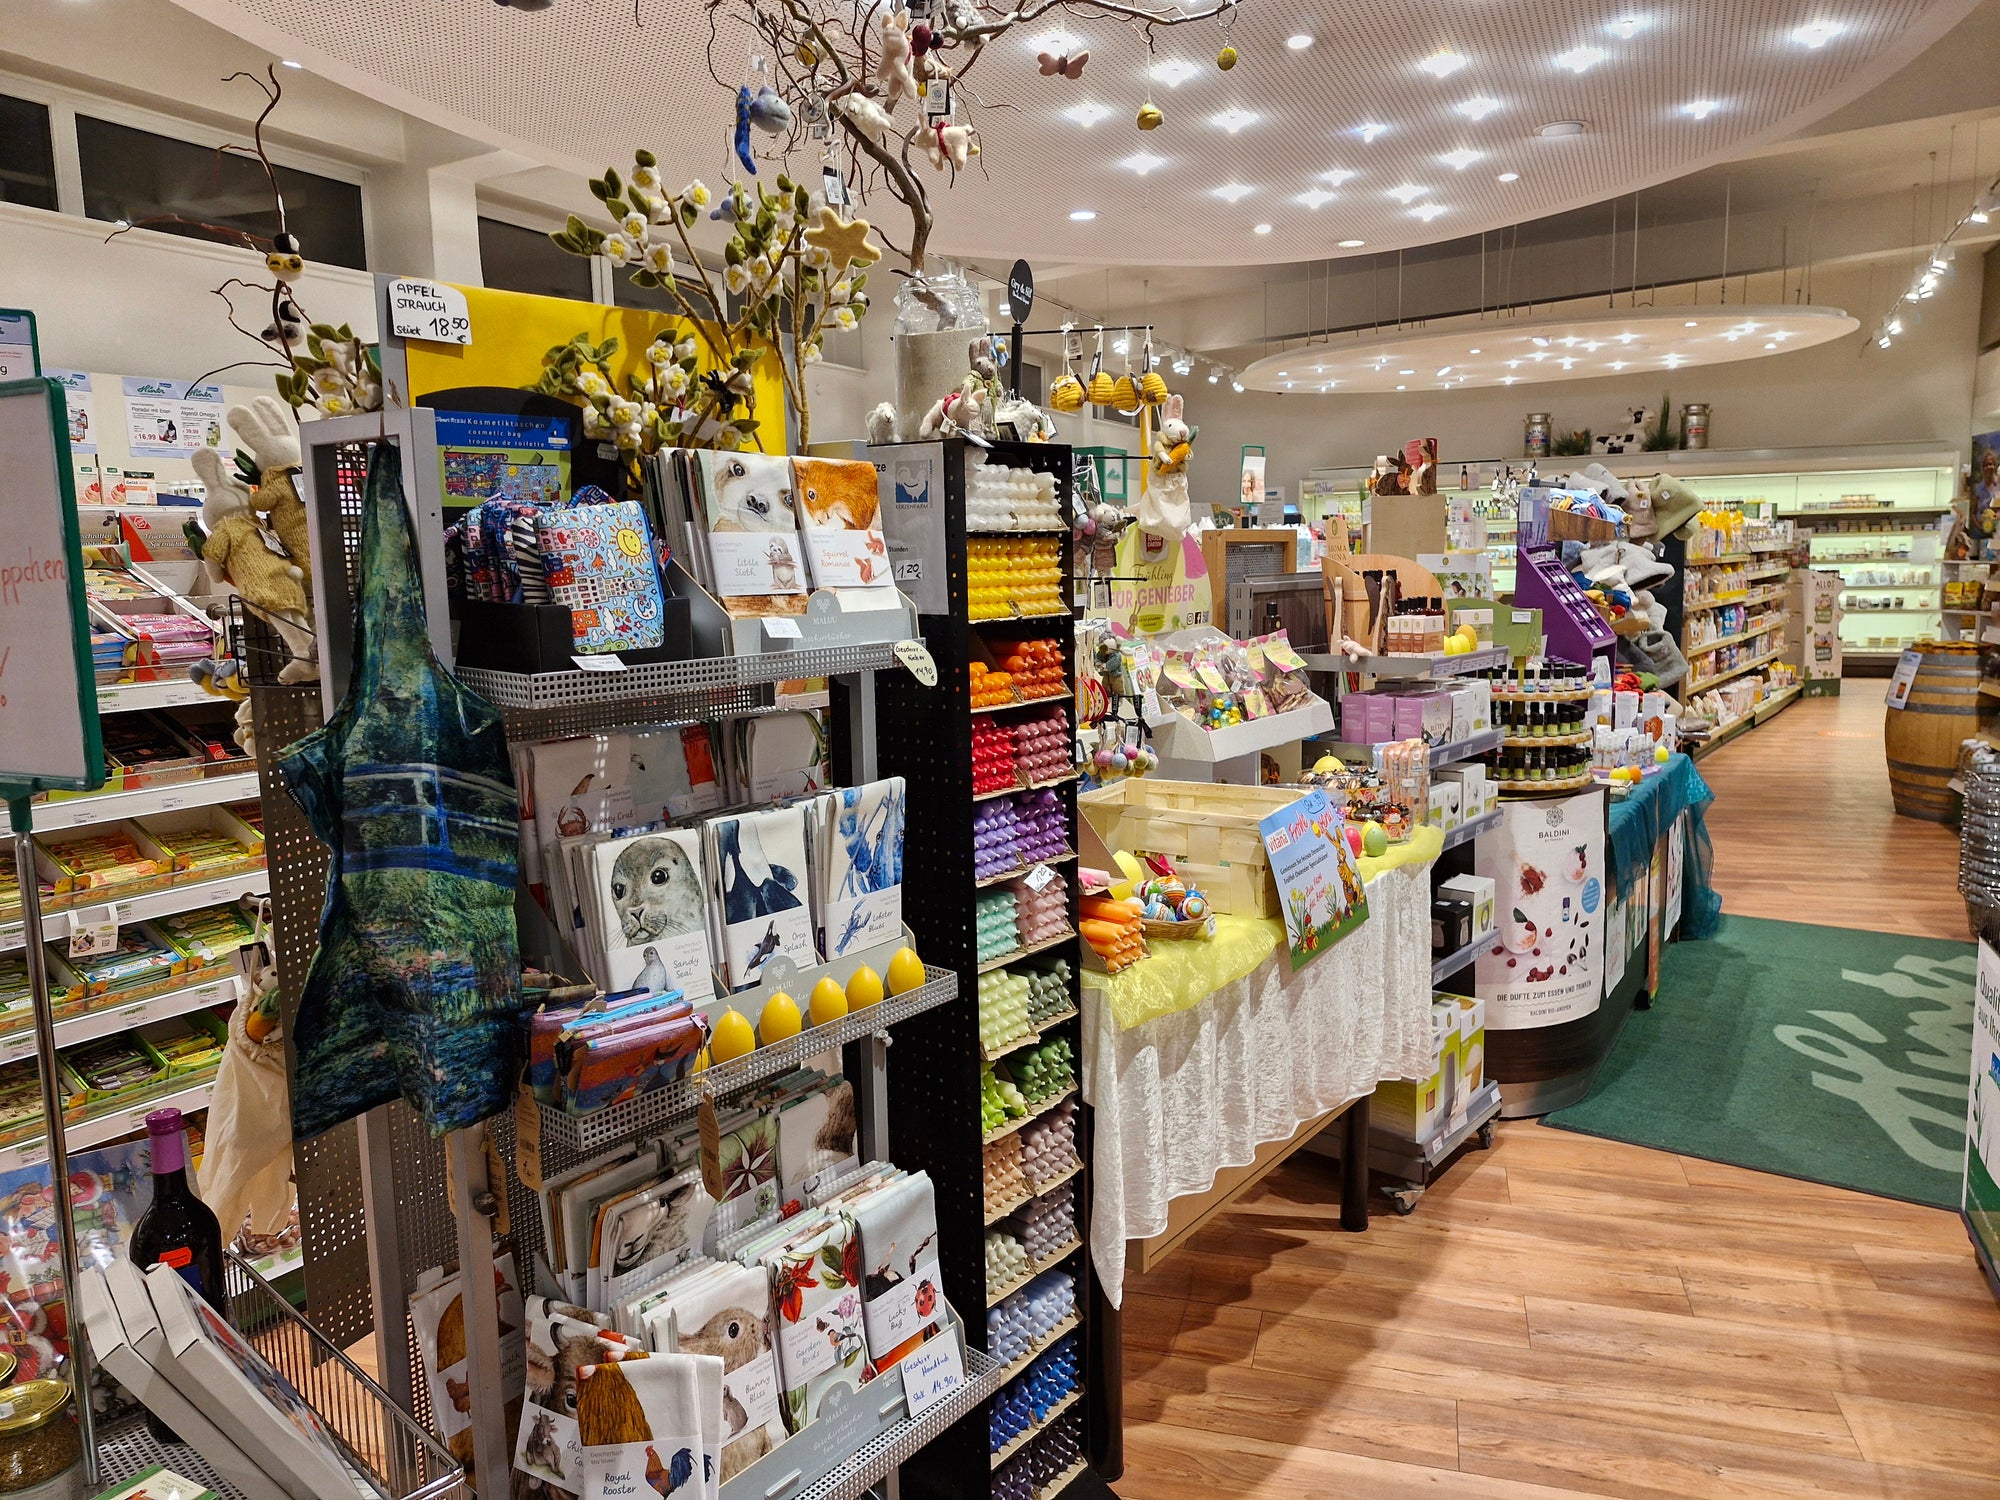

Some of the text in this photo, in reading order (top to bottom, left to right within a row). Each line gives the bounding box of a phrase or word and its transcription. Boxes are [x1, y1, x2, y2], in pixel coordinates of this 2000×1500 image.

[397, 283, 443, 298] APFEL
[397, 298, 447, 313] STRAUCH
[396, 325, 422, 336] Stück
[467, 418, 546, 429] Kosmetiktaschen
[138, 433, 156, 441] 16,99
[468, 429, 522, 438] cosmetic bag
[468, 438, 499, 446] trousse
[514, 440, 545, 448] toilette
[822, 549, 850, 559] Squirrel
[737, 557, 760, 567] Little
[821, 560, 851, 568] Romance
[735, 567, 757, 577] Sloth
[813, 616, 838, 625] MALUU
[617, 809, 635, 821] Crab
[1538, 829, 1570, 839] BALDINI
[1268, 833, 1289, 852] vitana
[872, 911, 894, 922] Lobster
[3, 926, 25, 935] vegan
[791, 932, 807, 940] Orca
[784, 942, 808, 955] Splash
[673, 956, 700, 969] Sandy
[675, 970, 694, 979] Seal
[1496, 993, 1508, 1002] DIE
[1532, 991, 1546, 1000] ZUM
[1547, 988, 1564, 997] ESSEN
[1565, 985, 1576, 994] UND
[122, 1005, 143, 1016] vegan
[1530, 1009, 1548, 1017] BALDINI
[8, 1036, 31, 1047] vegan
[888, 1306, 908, 1323] Lucky
[890, 1319, 903, 1331] Bug
[795, 1340, 822, 1359] Garden
[801, 1351, 820, 1367] Birds
[745, 1375, 771, 1394] Bunny
[749, 1389, 766, 1404] Bliss
[825, 1403, 849, 1425] MALUU
[604, 1471, 632, 1485] Royal
[602, 1484, 637, 1496] Rooster
